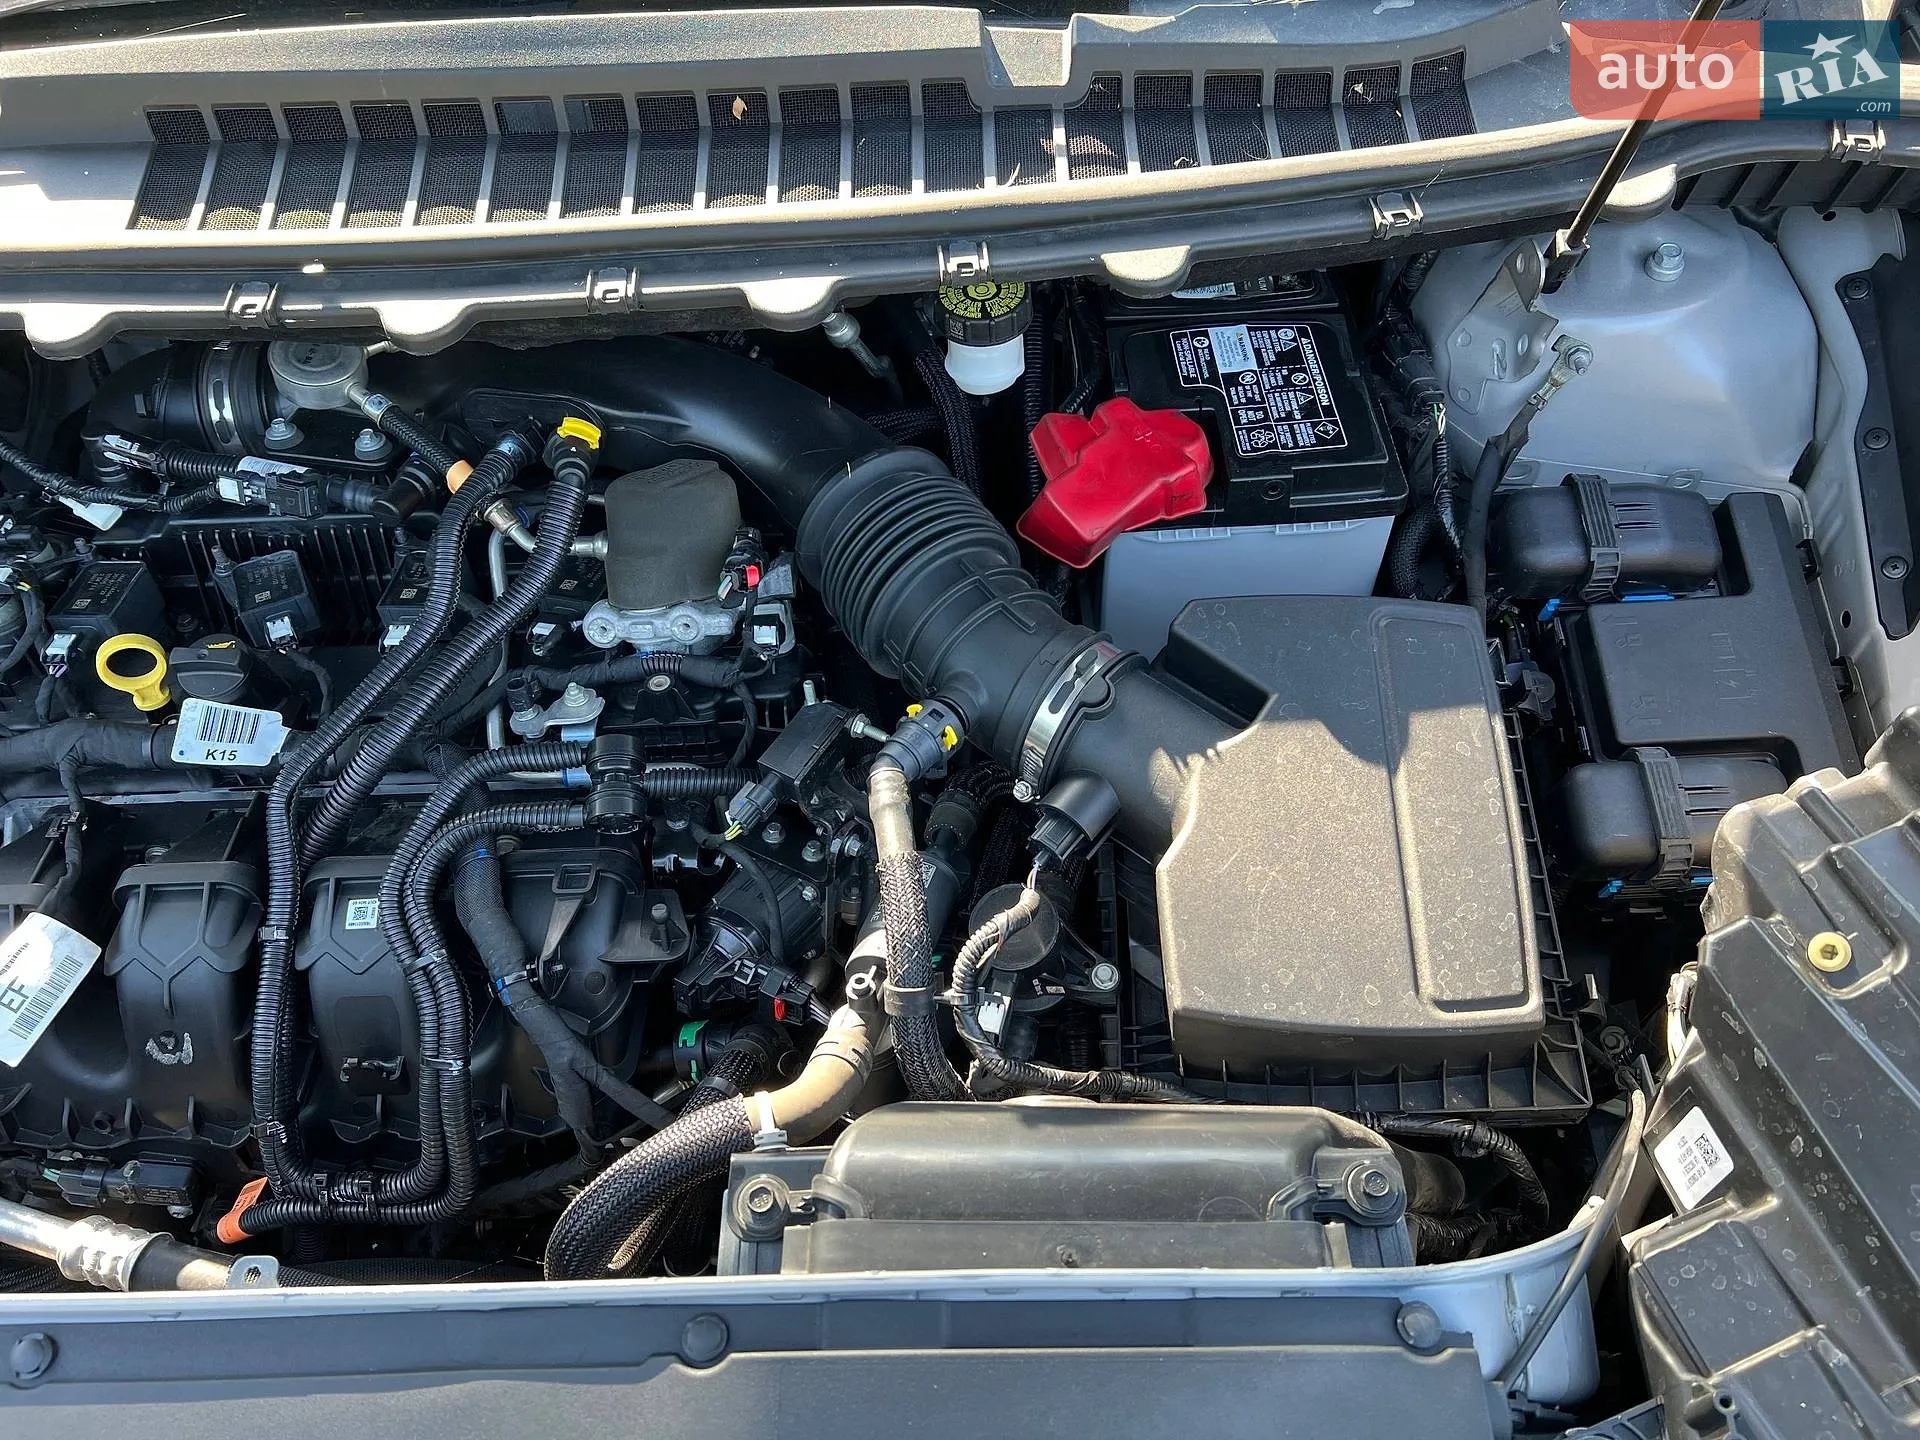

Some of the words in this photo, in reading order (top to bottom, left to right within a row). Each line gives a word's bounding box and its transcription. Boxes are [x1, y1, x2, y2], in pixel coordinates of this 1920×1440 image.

[1180, 337, 1196, 377] NON-SPILLABLE
[1302, 343, 1330, 405] DANGER/POISON
[205, 748, 238, 761] K15
